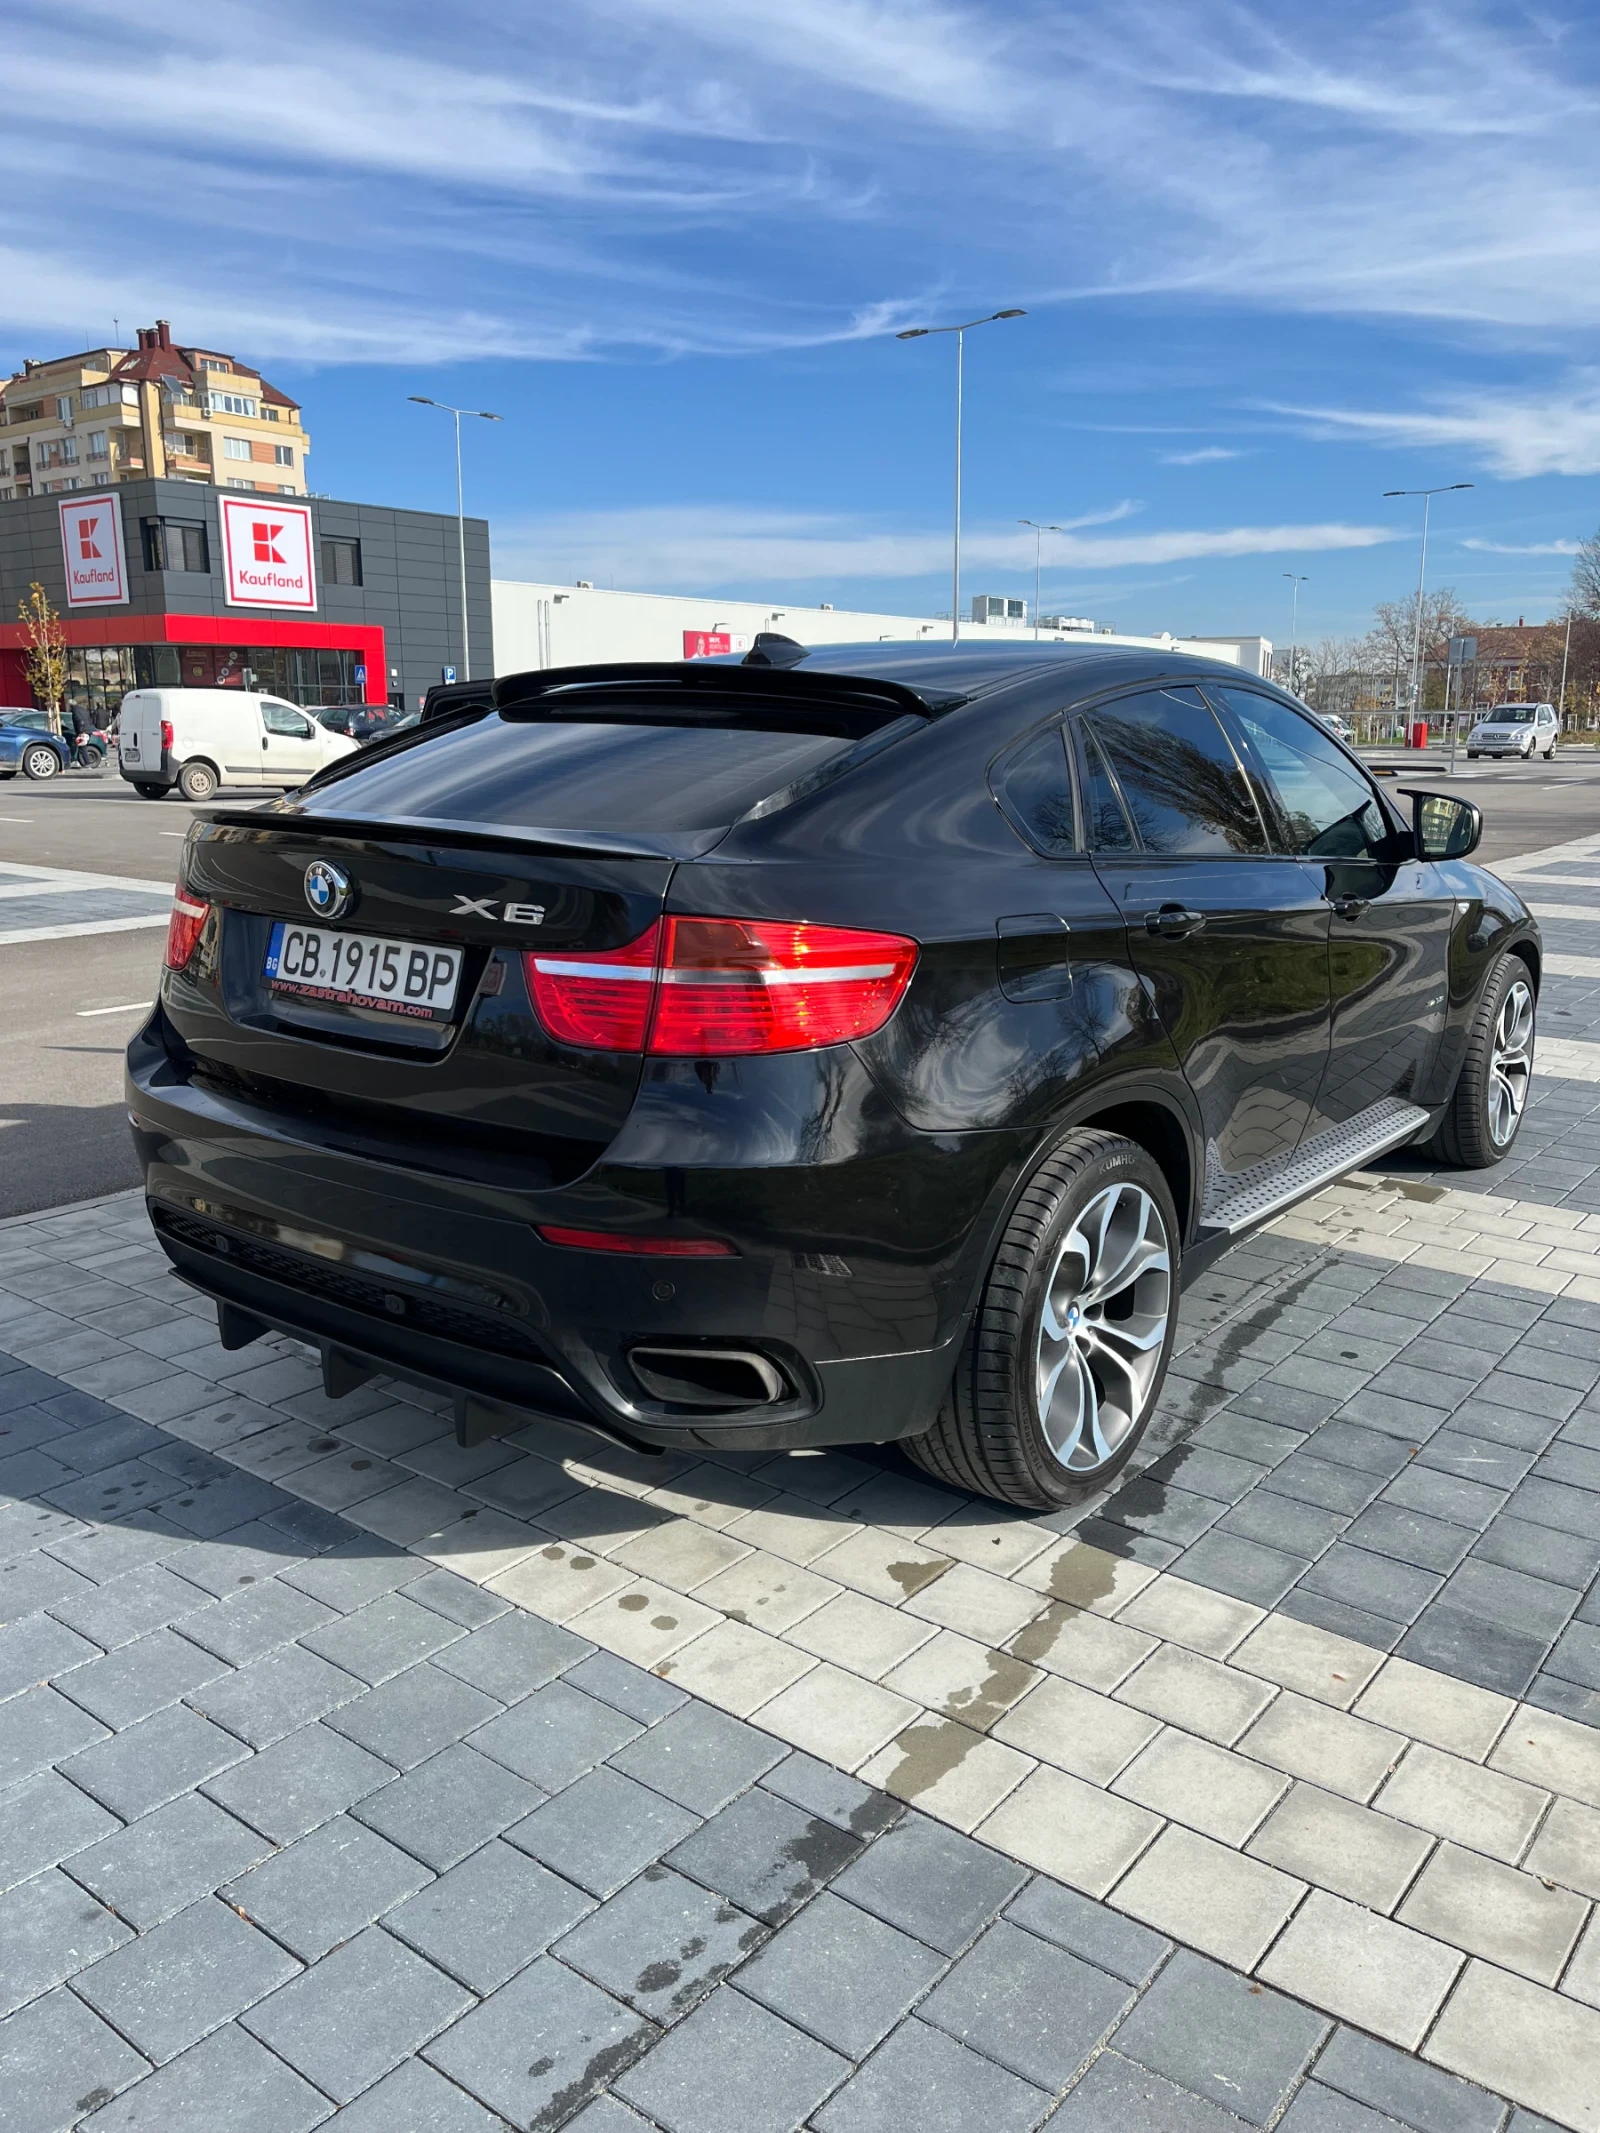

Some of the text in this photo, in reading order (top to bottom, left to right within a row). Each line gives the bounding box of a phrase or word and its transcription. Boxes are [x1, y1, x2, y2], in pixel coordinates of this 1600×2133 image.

[73, 567, 115, 585] Kaufland
[239, 570, 304, 589] Kaufland
[448, 894, 546, 926] X6
[265, 956, 279, 971] BG
[271, 980, 433, 1018] www.zastrahovam.com
[1099, 1154, 1136, 1175] KUMHO
